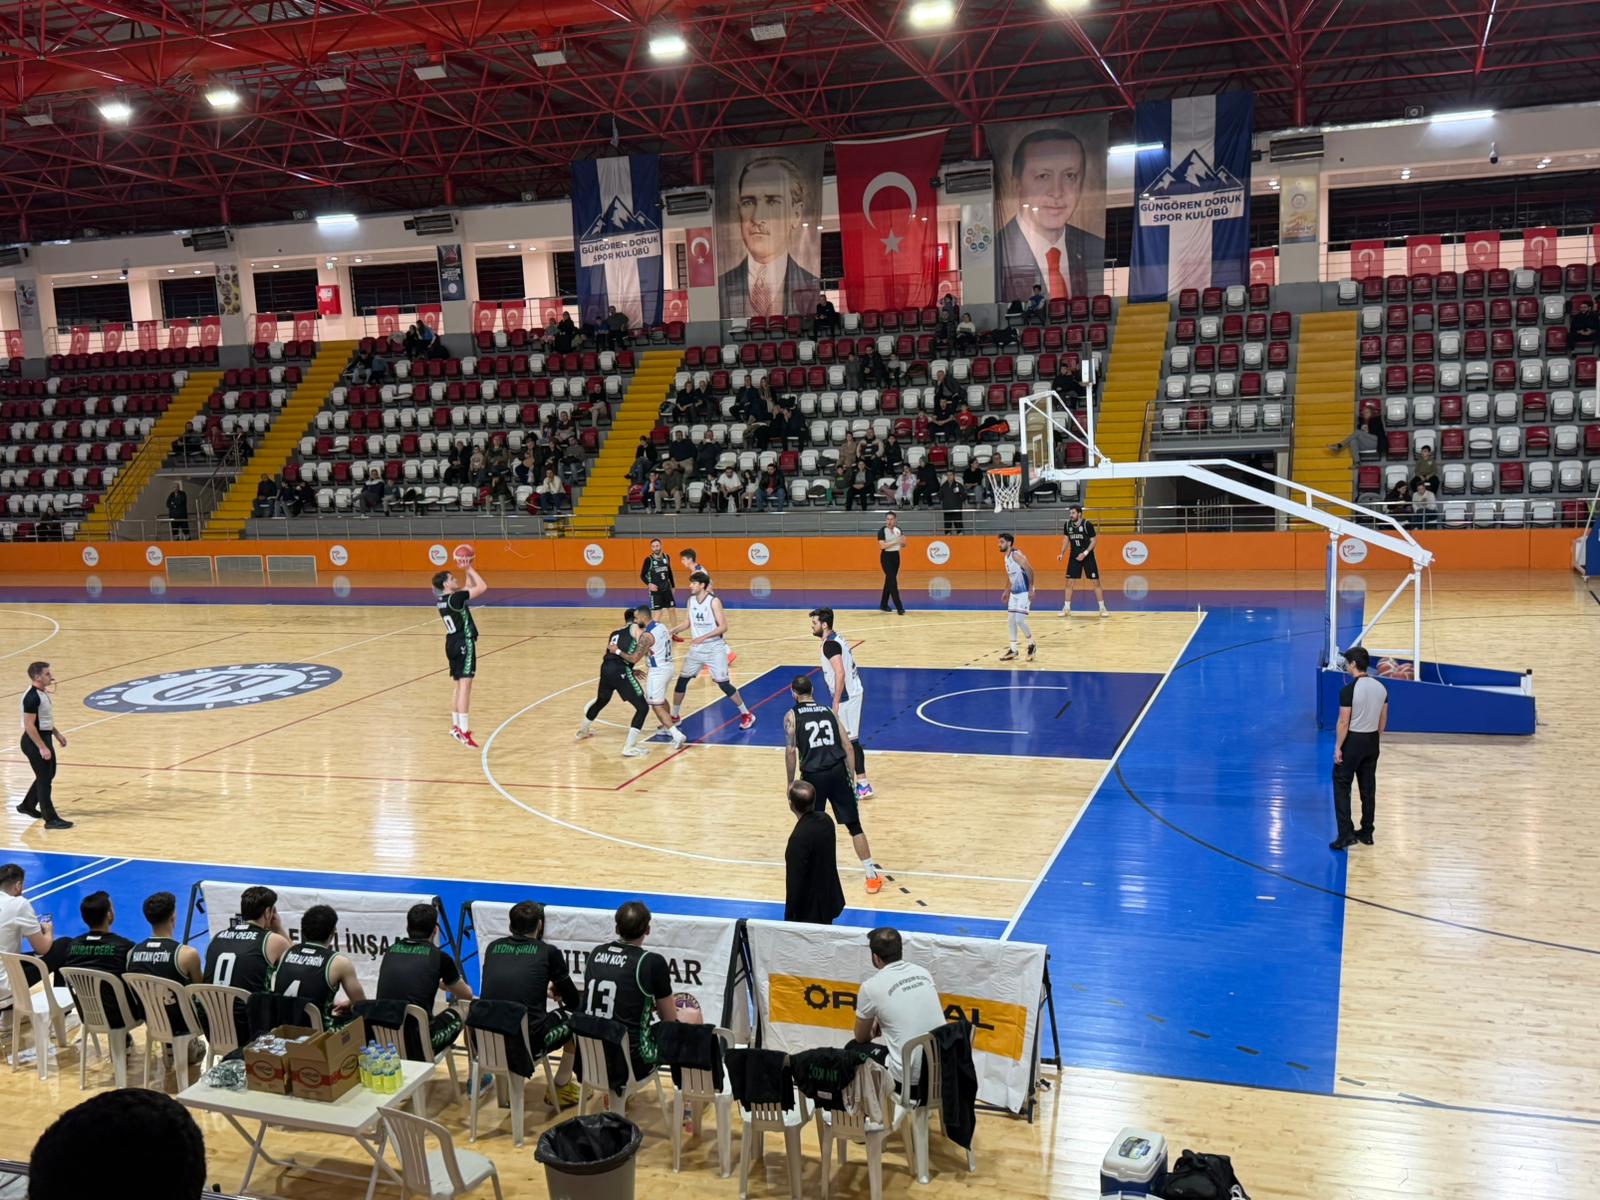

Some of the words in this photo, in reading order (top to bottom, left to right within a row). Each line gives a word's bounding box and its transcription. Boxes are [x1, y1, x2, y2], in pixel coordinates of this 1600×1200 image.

[1141, 200, 1201, 212] GÜNGÖREN
[1205, 194, 1242, 207] DORUK
[1153, 213, 1182, 222] SPOR
[1185, 206, 1229, 220] KULÜBÜ
[629, 235, 659, 247] DORUK
[593, 252, 614, 262] SPOR
[615, 246, 650, 259] KULÜBÜ
[804, 719, 835, 748] 23
[236, 931, 259, 940] DEDE
[594, 952, 611, 963] CAN
[609, 954, 628, 968] KOÇ
[584, 978, 618, 1020] 13
